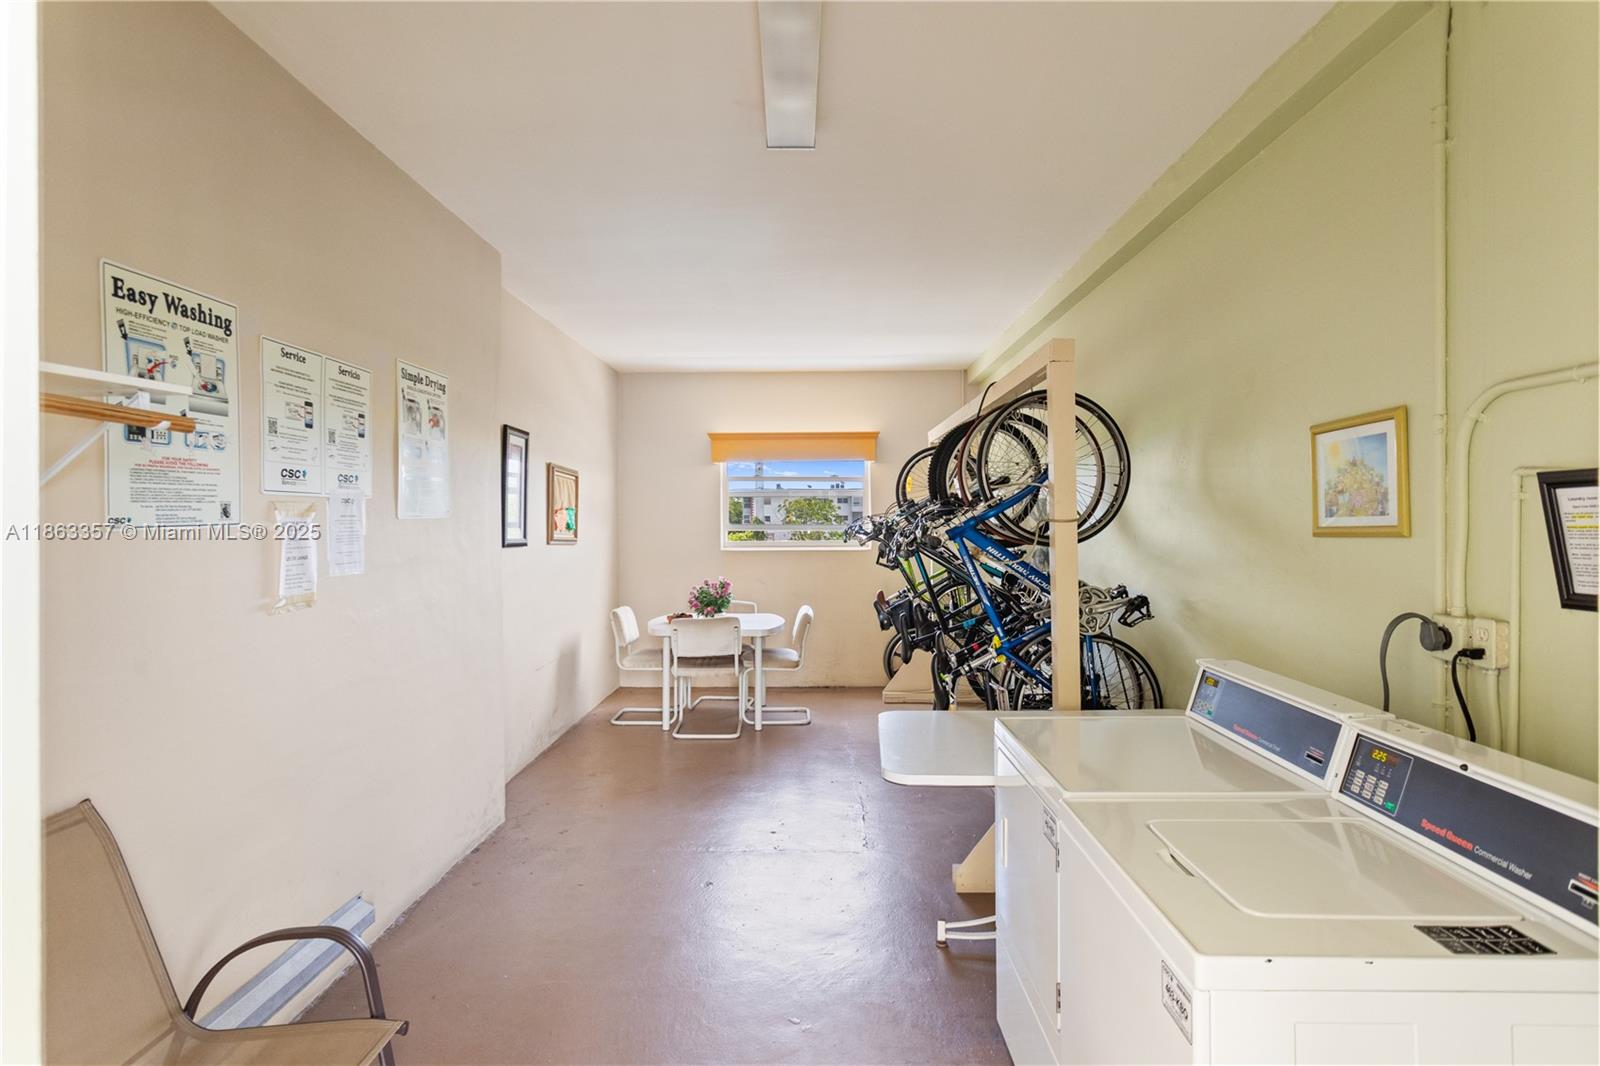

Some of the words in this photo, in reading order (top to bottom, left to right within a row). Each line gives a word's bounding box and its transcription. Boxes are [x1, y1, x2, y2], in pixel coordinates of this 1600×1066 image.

[111, 275, 159, 314] Easy
[162, 292, 233, 337] Washing
[115, 307, 170, 328] HIGH-EFFICIENCY
[179, 324, 191, 333] TOP
[191, 327, 206, 338] LOAD
[207, 332, 229, 344] WASHER
[280, 347, 307, 364] Service
[338, 365, 361, 381] Servicio
[401, 367, 424, 386] Simple
[424, 375, 446, 395] Drying
[280, 468, 301, 479] CSC
[337, 473, 354, 483] CSC
[1421, 819, 1446, 837] Speed
[1446, 831, 1473, 851] Queen
[1474, 846, 1508, 868] Commercial
[1509, 861, 1533, 880] Washer
